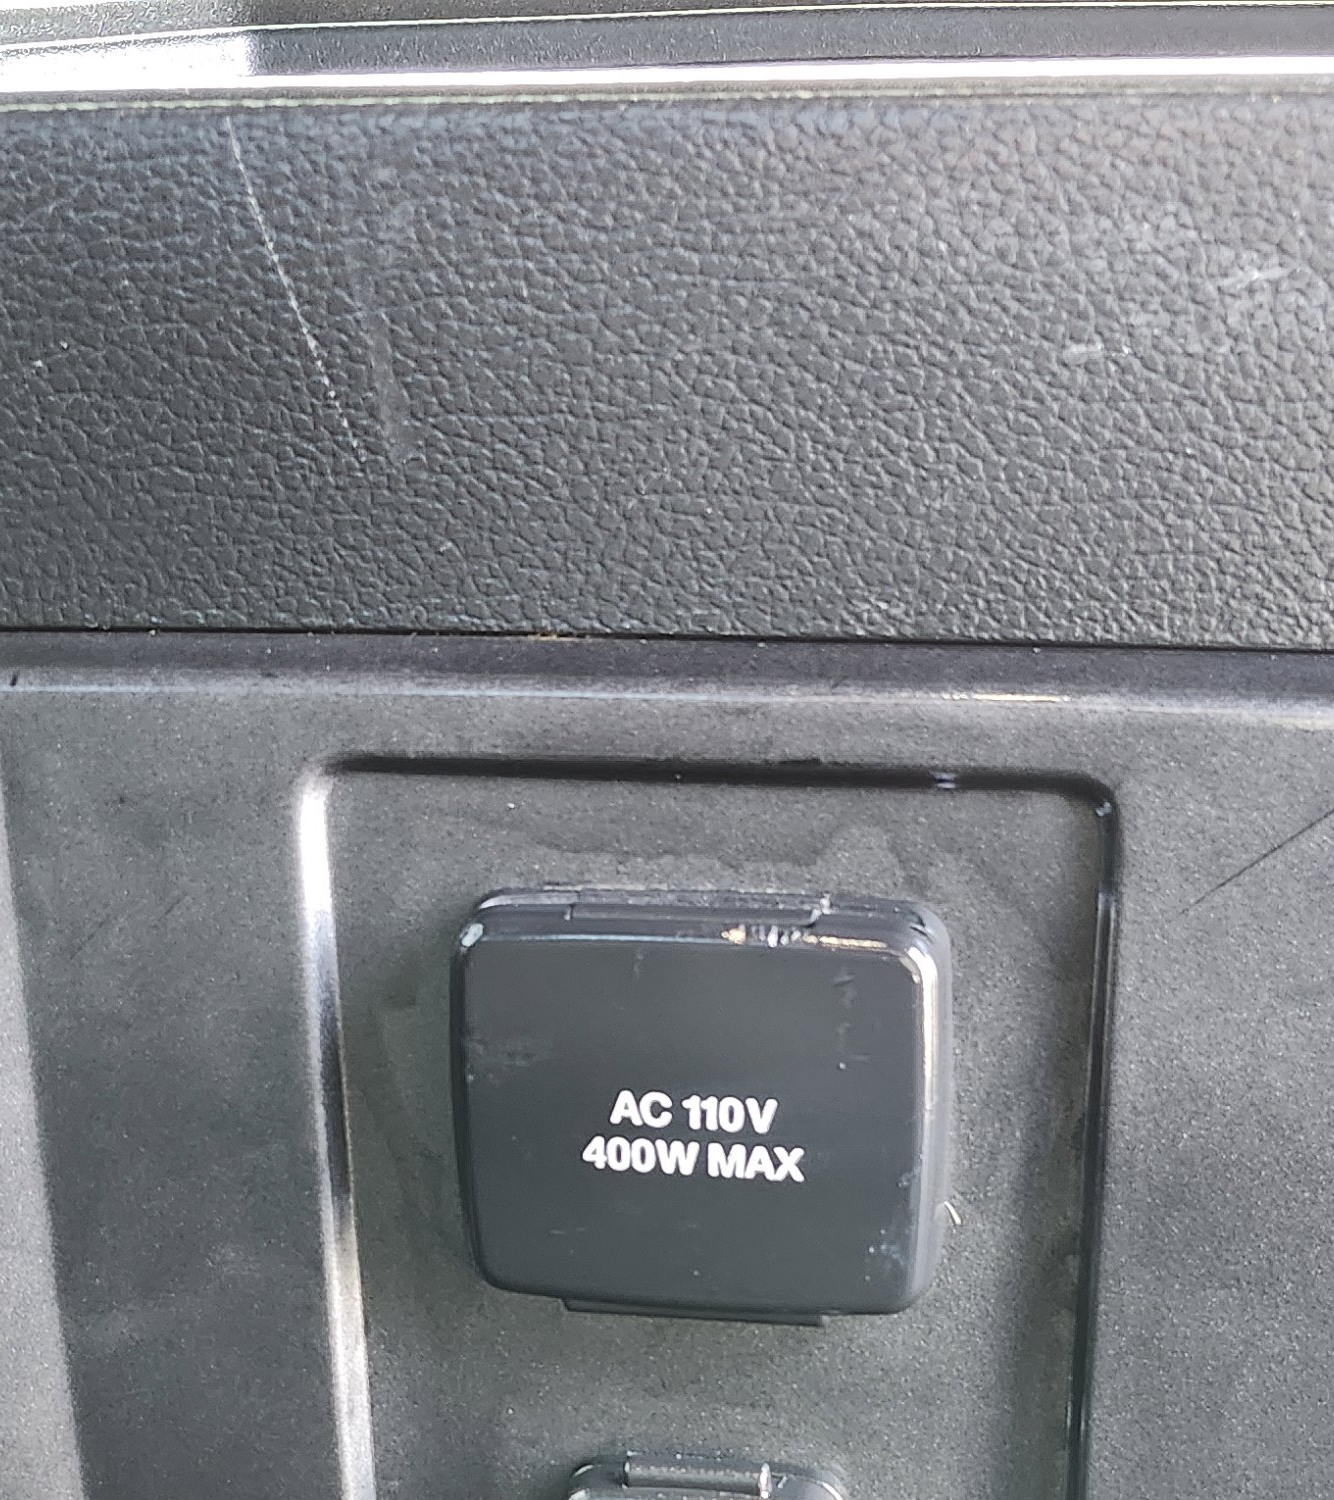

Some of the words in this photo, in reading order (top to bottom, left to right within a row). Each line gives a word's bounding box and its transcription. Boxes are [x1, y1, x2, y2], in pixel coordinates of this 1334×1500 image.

[609, 1089, 673, 1129] AC
[681, 1094, 779, 1135] 110V
[582, 1135, 700, 1176] 400W
[707, 1142, 805, 1183] MAX
